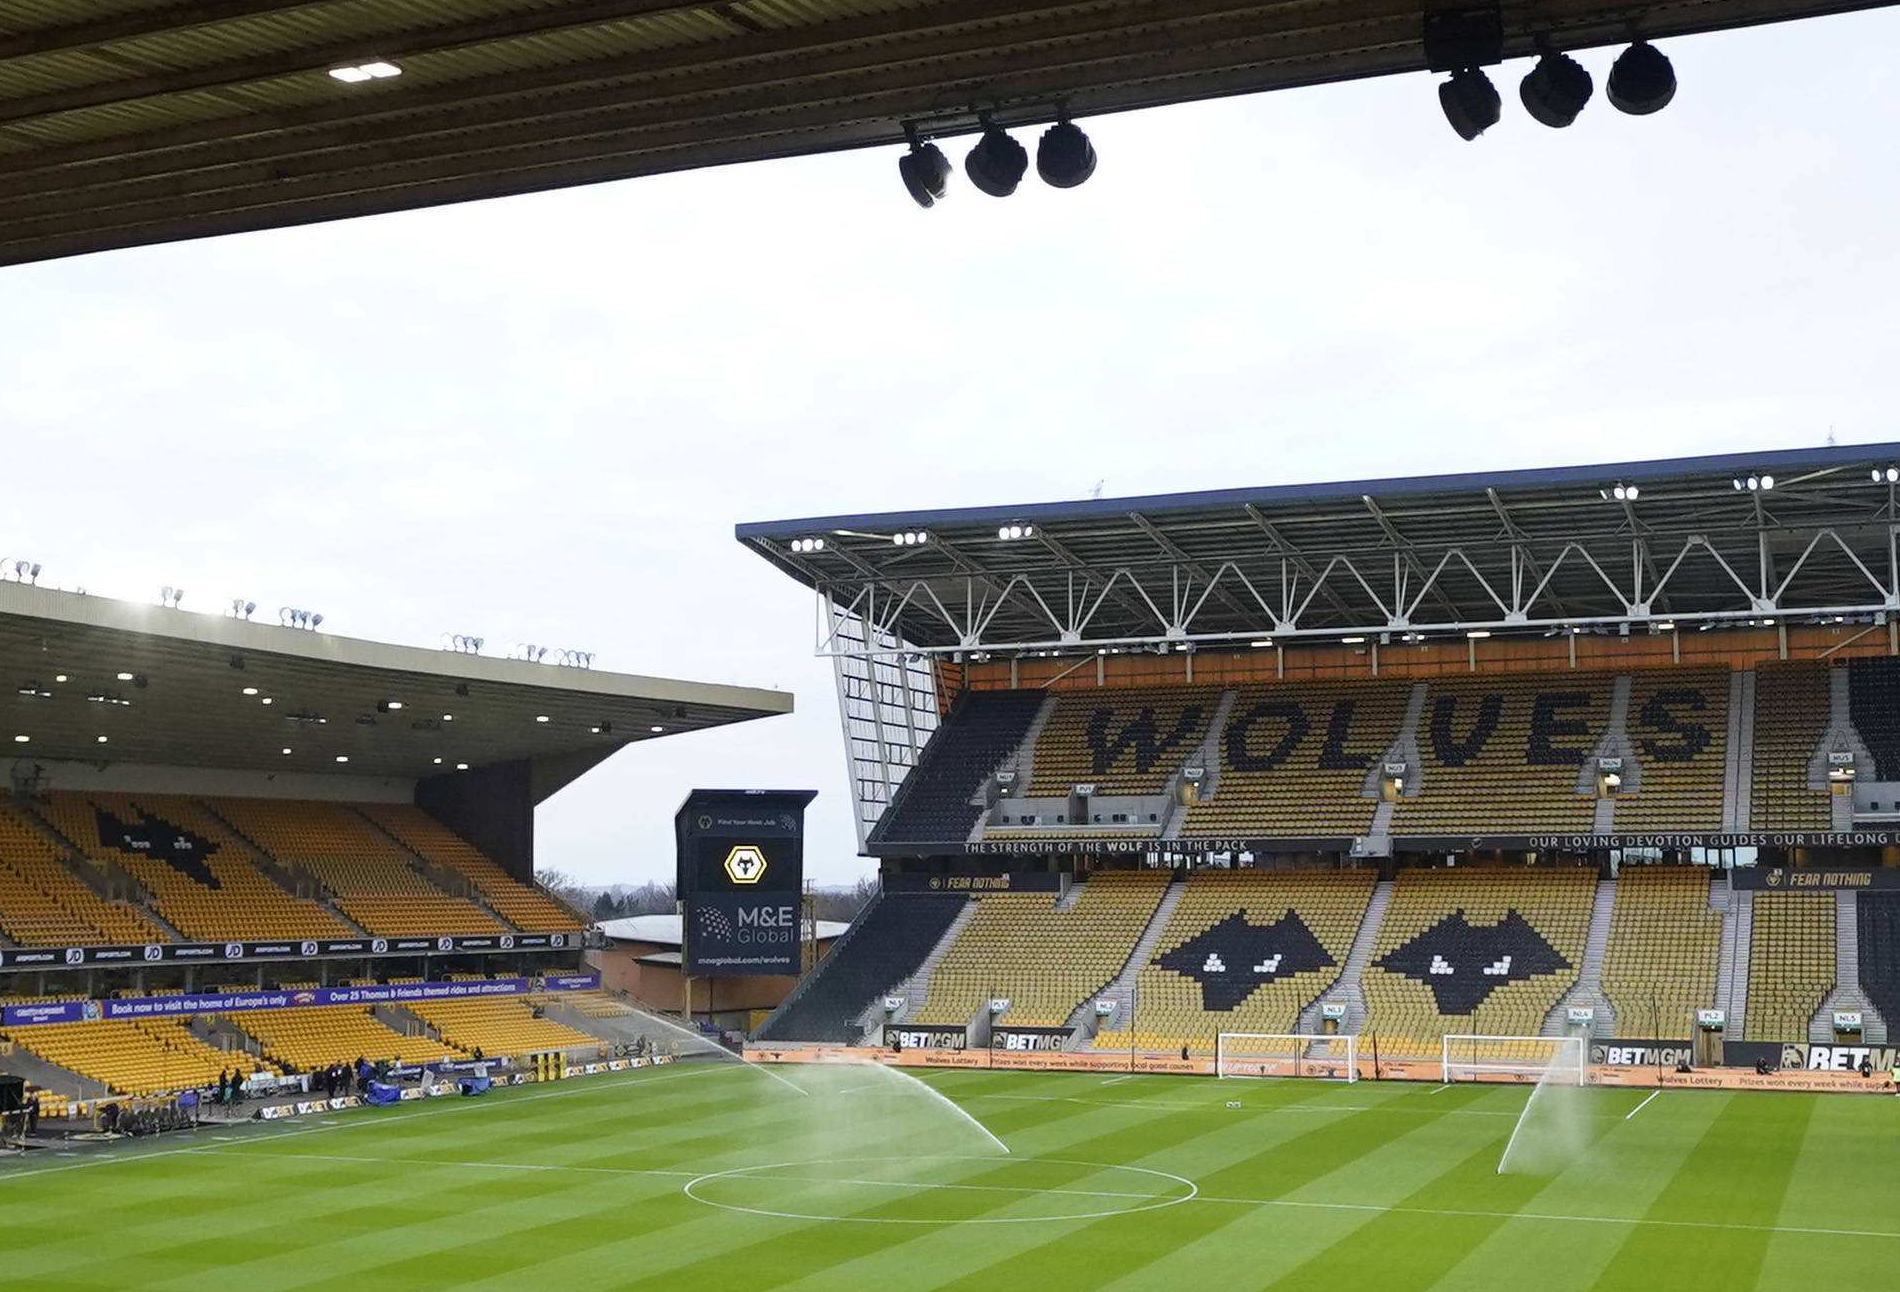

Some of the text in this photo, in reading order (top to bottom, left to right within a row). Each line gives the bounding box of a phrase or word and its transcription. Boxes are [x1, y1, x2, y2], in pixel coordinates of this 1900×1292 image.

[1086, 689, 1711, 774] WOLVES
[965, 840, 1246, 853] THE STRENGTH OF THE WOLF IS IN THE PACK
[1529, 837, 1558, 848] OUR
[1564, 836, 1619, 847] LOVING
[1626, 835, 1703, 846] DEVOTION
[1710, 835, 1767, 845] GUIDES
[1773, 834, 1805, 845] OUR
[1812, 833, 1888, 844] LIFELONG
[948, 877, 1009, 889] FEAR NOTHING
[1790, 872, 1871, 886] FEAR NOTHING
[738, 907, 793, 926] M&E
[738, 928, 793, 942] Global
[112, 1001, 132, 1014] Book
[133, 1002, 152, 1012] now
[154, 1001, 163, 1011] to
[183, 999, 198, 1009] the
[199, 997, 223, 1009] home
[224, 996, 234, 1007] of
[235, 995, 269, 1009] Europe's
[901, 1034, 964, 1049] BETMGM
[1608, 1047, 1691, 1066] BETMGM
[1692, 1077, 1722, 1087] Lottery
[1767, 1078, 1785, 1087] won
[1787, 1079, 1811, 1090] every
[1814, 1079, 1836, 1089] week
[1839, 1079, 1862, 1089] while
